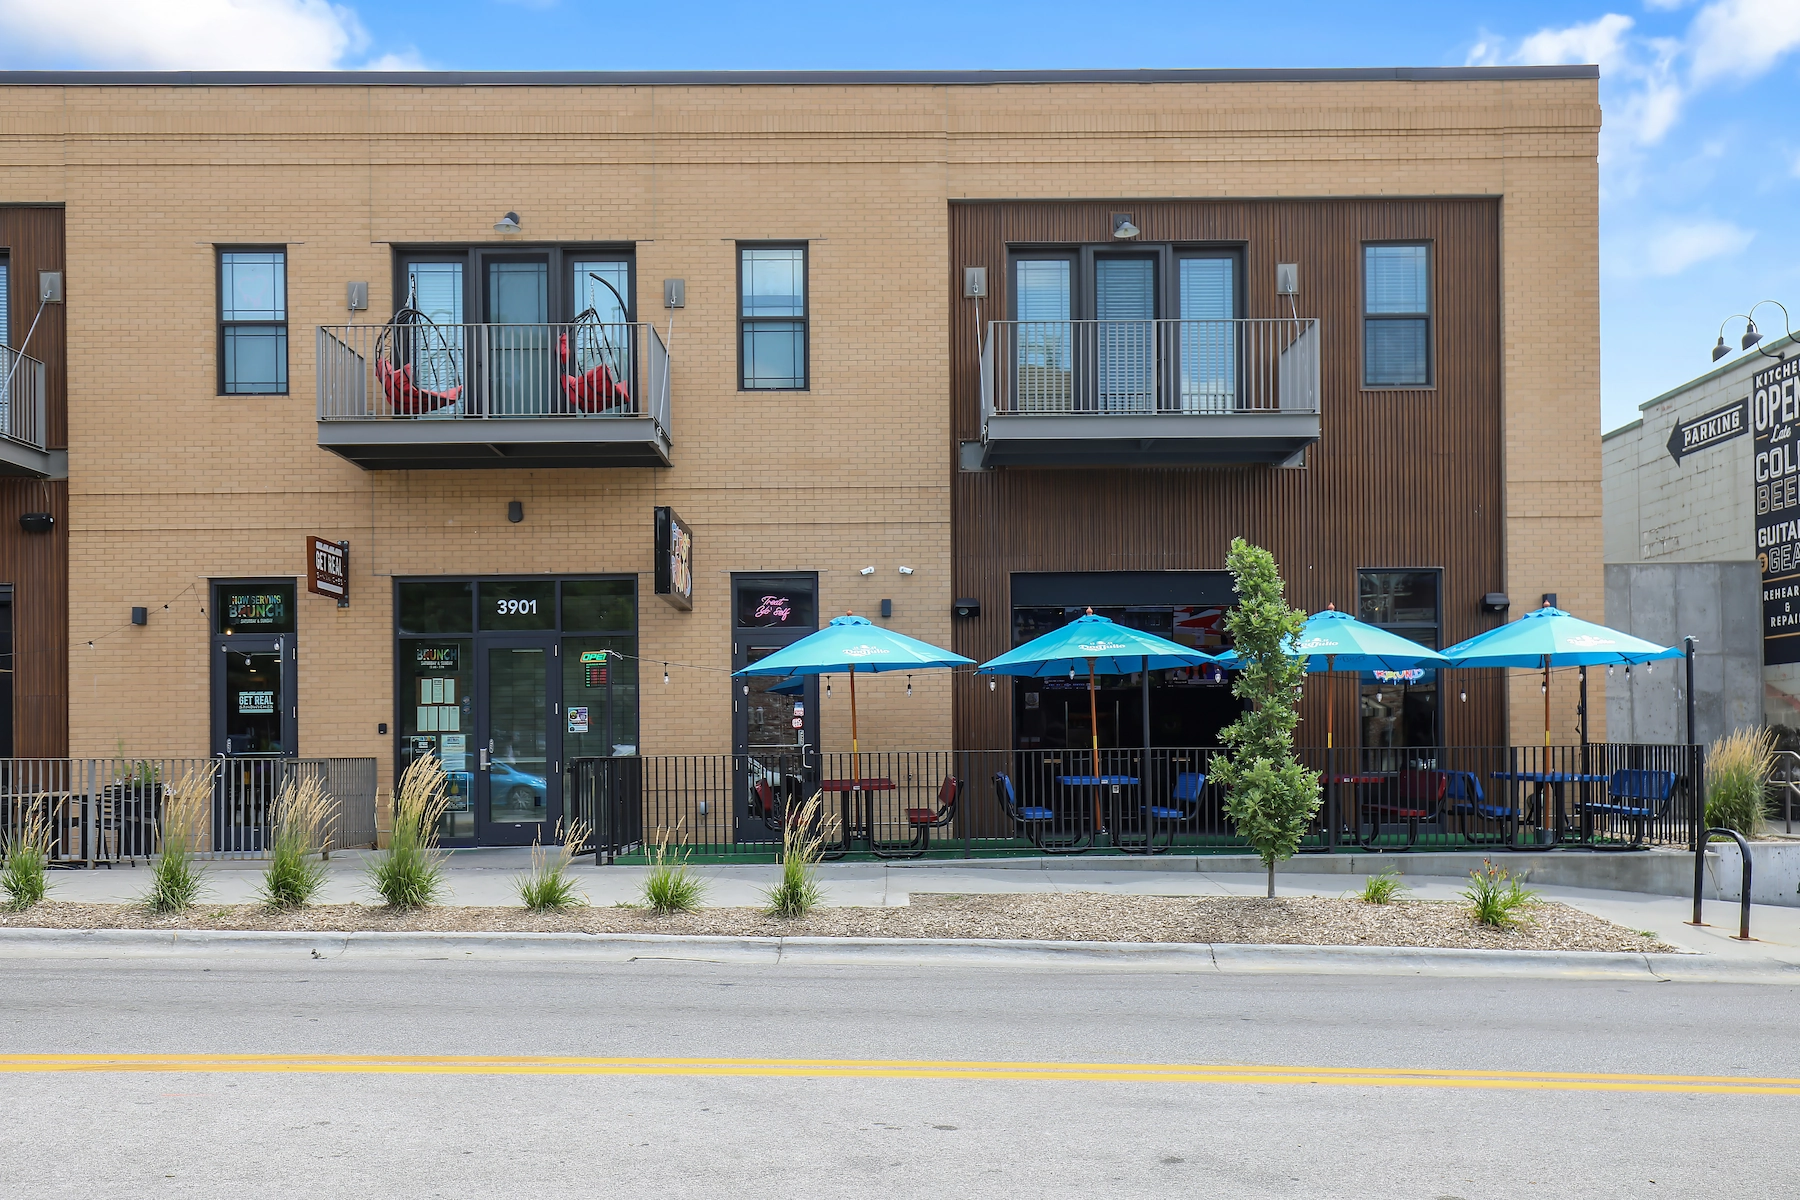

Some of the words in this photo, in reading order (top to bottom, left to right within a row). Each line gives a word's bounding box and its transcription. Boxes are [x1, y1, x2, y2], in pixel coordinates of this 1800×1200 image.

[1756, 358, 1800, 389] KITCHE
[1684, 411, 1740, 446] PARKING
[1770, 424, 1792, 443] Late
[1756, 440, 1800, 483] COL
[1757, 473, 1800, 516] BEE
[1758, 519, 1800, 548] GUITA
[316, 550, 327, 572] GET
[328, 553, 343, 577] REAL
[231, 595, 250, 605] NOW
[761, 595, 789, 606] Treat
[1764, 585, 1800, 602] REHEAR
[228, 604, 284, 618] BRUNCH
[497, 599, 537, 615] 3901
[1770, 612, 1800, 628] REPAI
[416, 648, 457, 661] BRUNCH
[239, 695, 254, 705] GET
[254, 695, 274, 705] REAL
